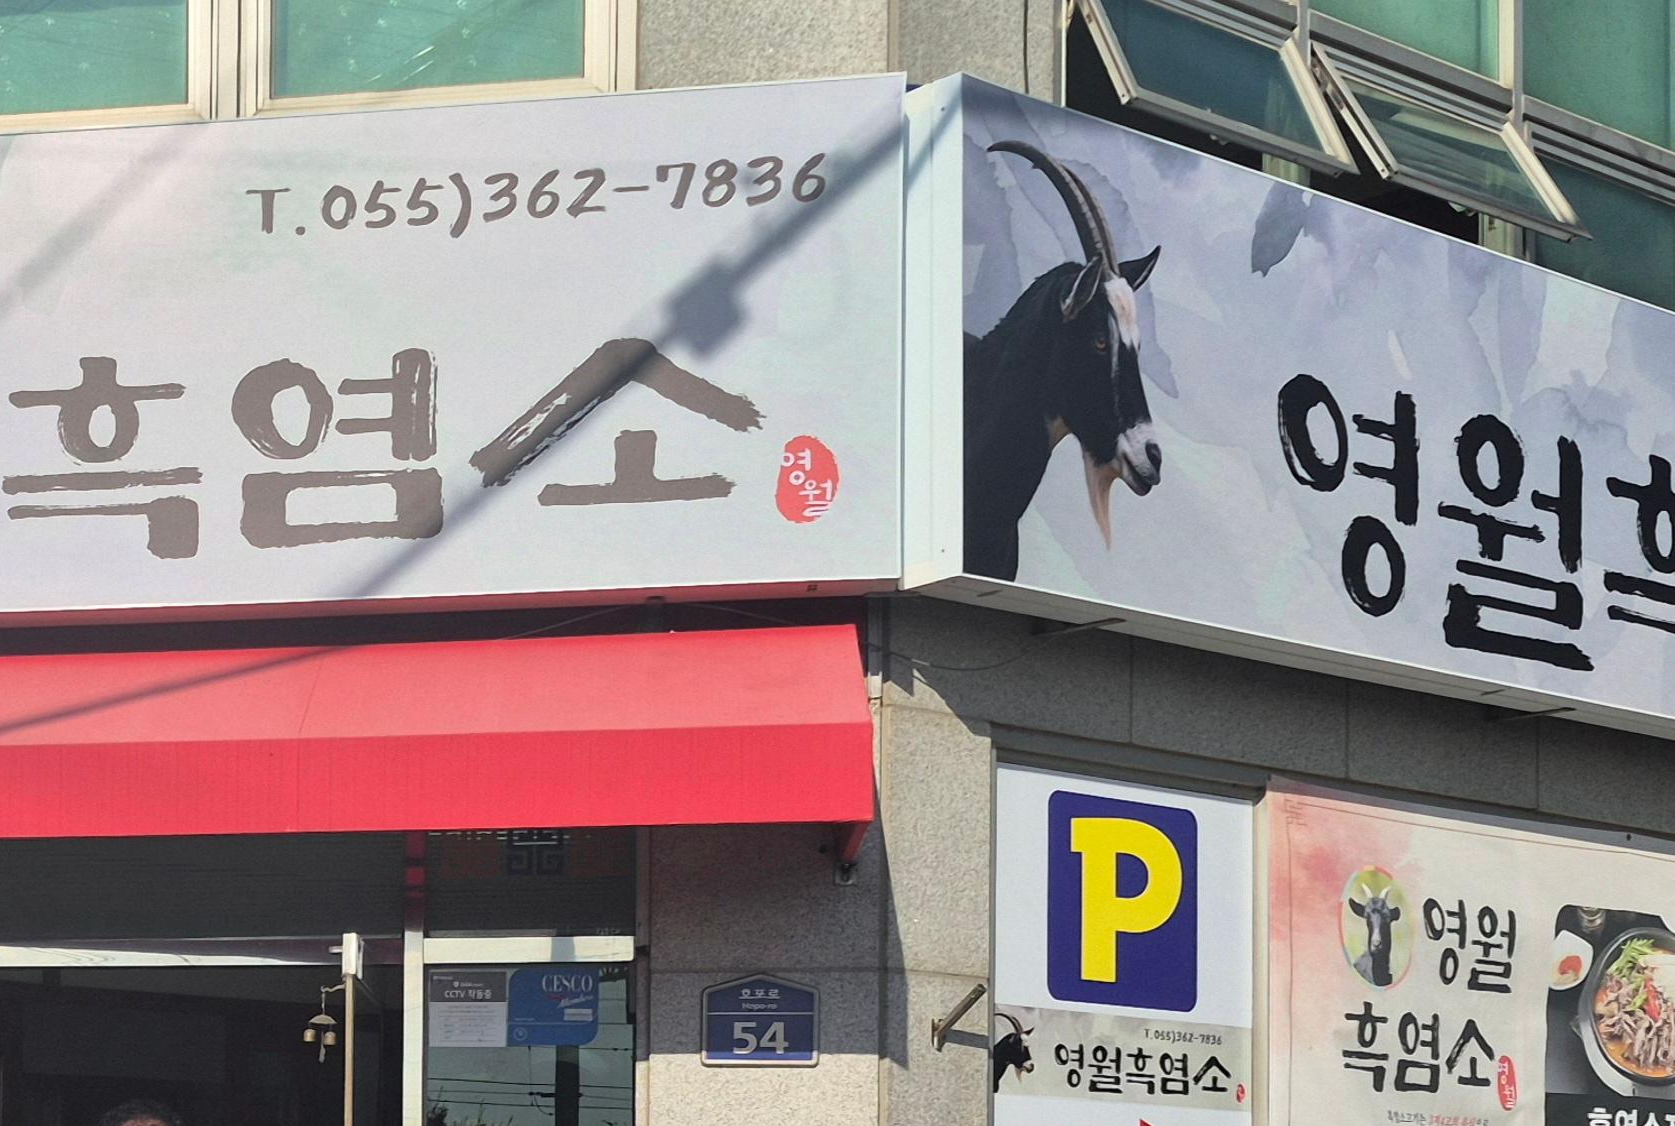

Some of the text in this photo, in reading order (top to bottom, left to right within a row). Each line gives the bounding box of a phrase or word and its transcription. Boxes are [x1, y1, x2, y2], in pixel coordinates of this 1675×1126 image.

[251, 152, 829, 240] T.055)362-7836
[1071, 817, 1183, 983] P
[1423, 897, 1517, 994] 영월
[445, 989, 465, 998] CCTV
[542, 975, 593, 993] CESCO
[732, 1021, 790, 1055] 54
[1144, 1028, 1222, 1046] T.055)362-7836
[1342, 1001, 1495, 1094] 흑염소
[1054, 1043, 1232, 1096] 영월흑염소
